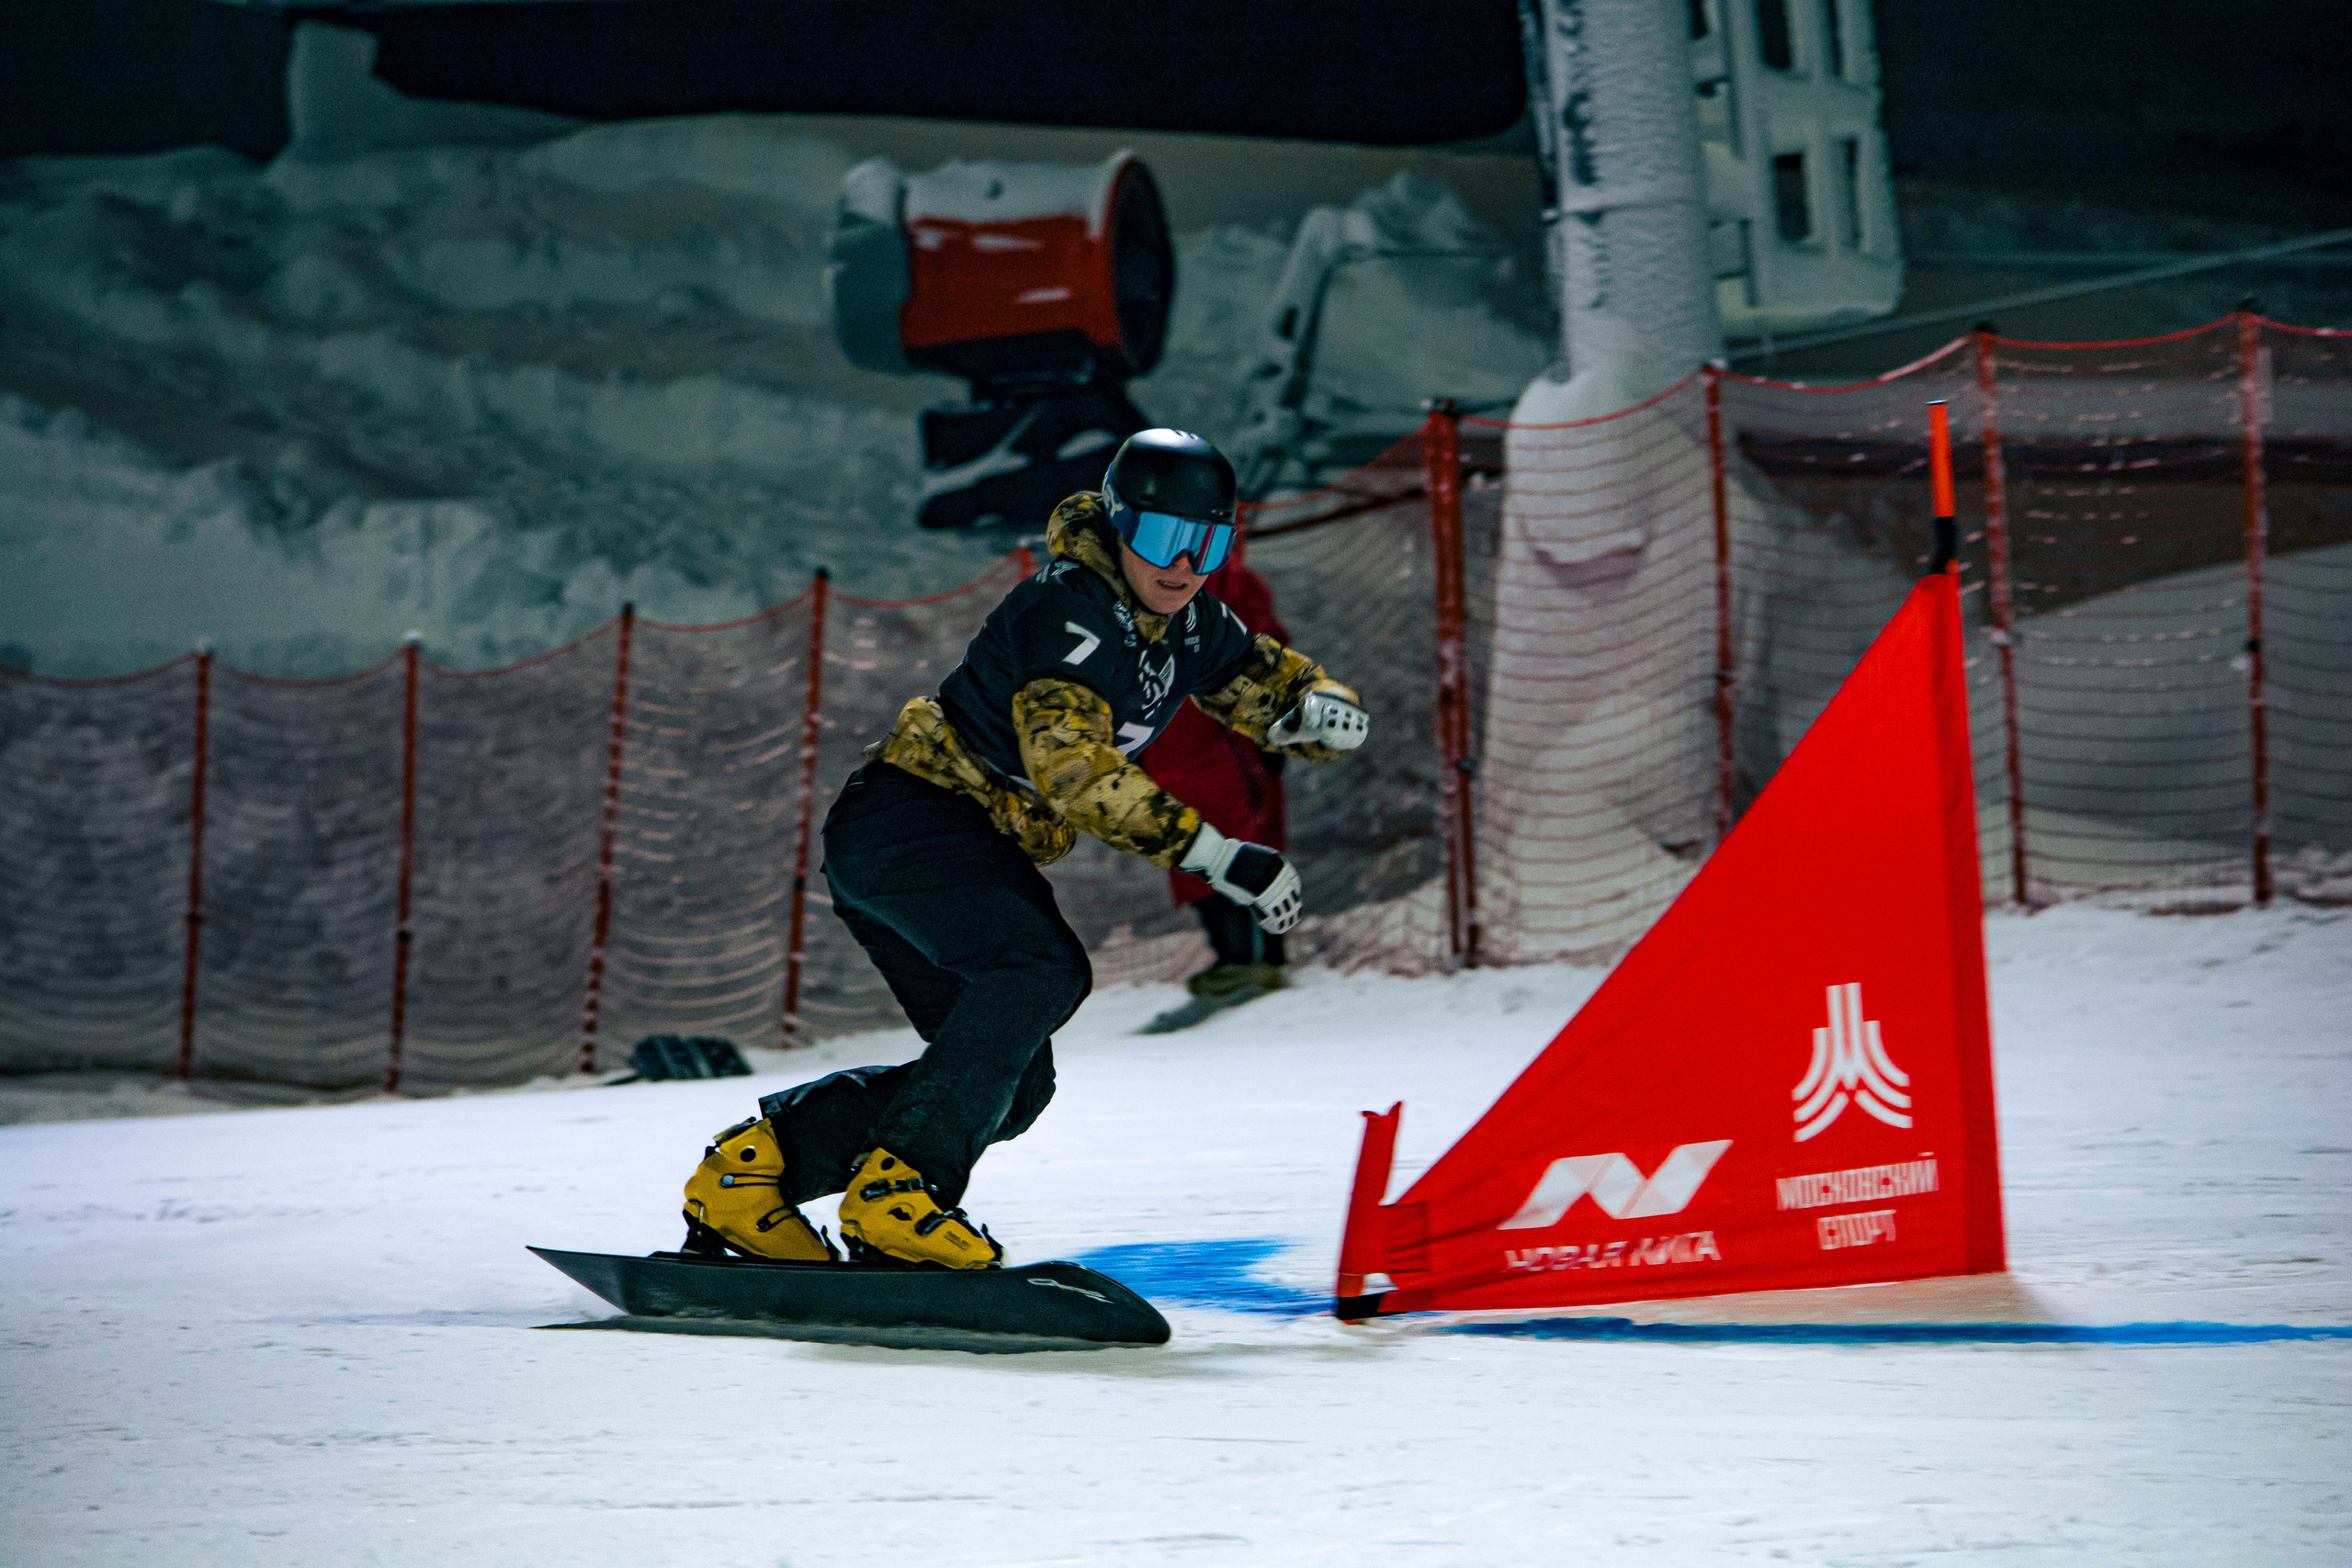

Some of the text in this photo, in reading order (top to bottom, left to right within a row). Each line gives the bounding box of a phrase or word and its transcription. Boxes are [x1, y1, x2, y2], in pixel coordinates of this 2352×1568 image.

[1060, 621, 1102, 666] 7
[1115, 721, 1156, 757] 7
[1775, 1151, 1940, 1212] МОСКОВСКИЙ
[1816, 1209, 1897, 1250] СПОРТ
